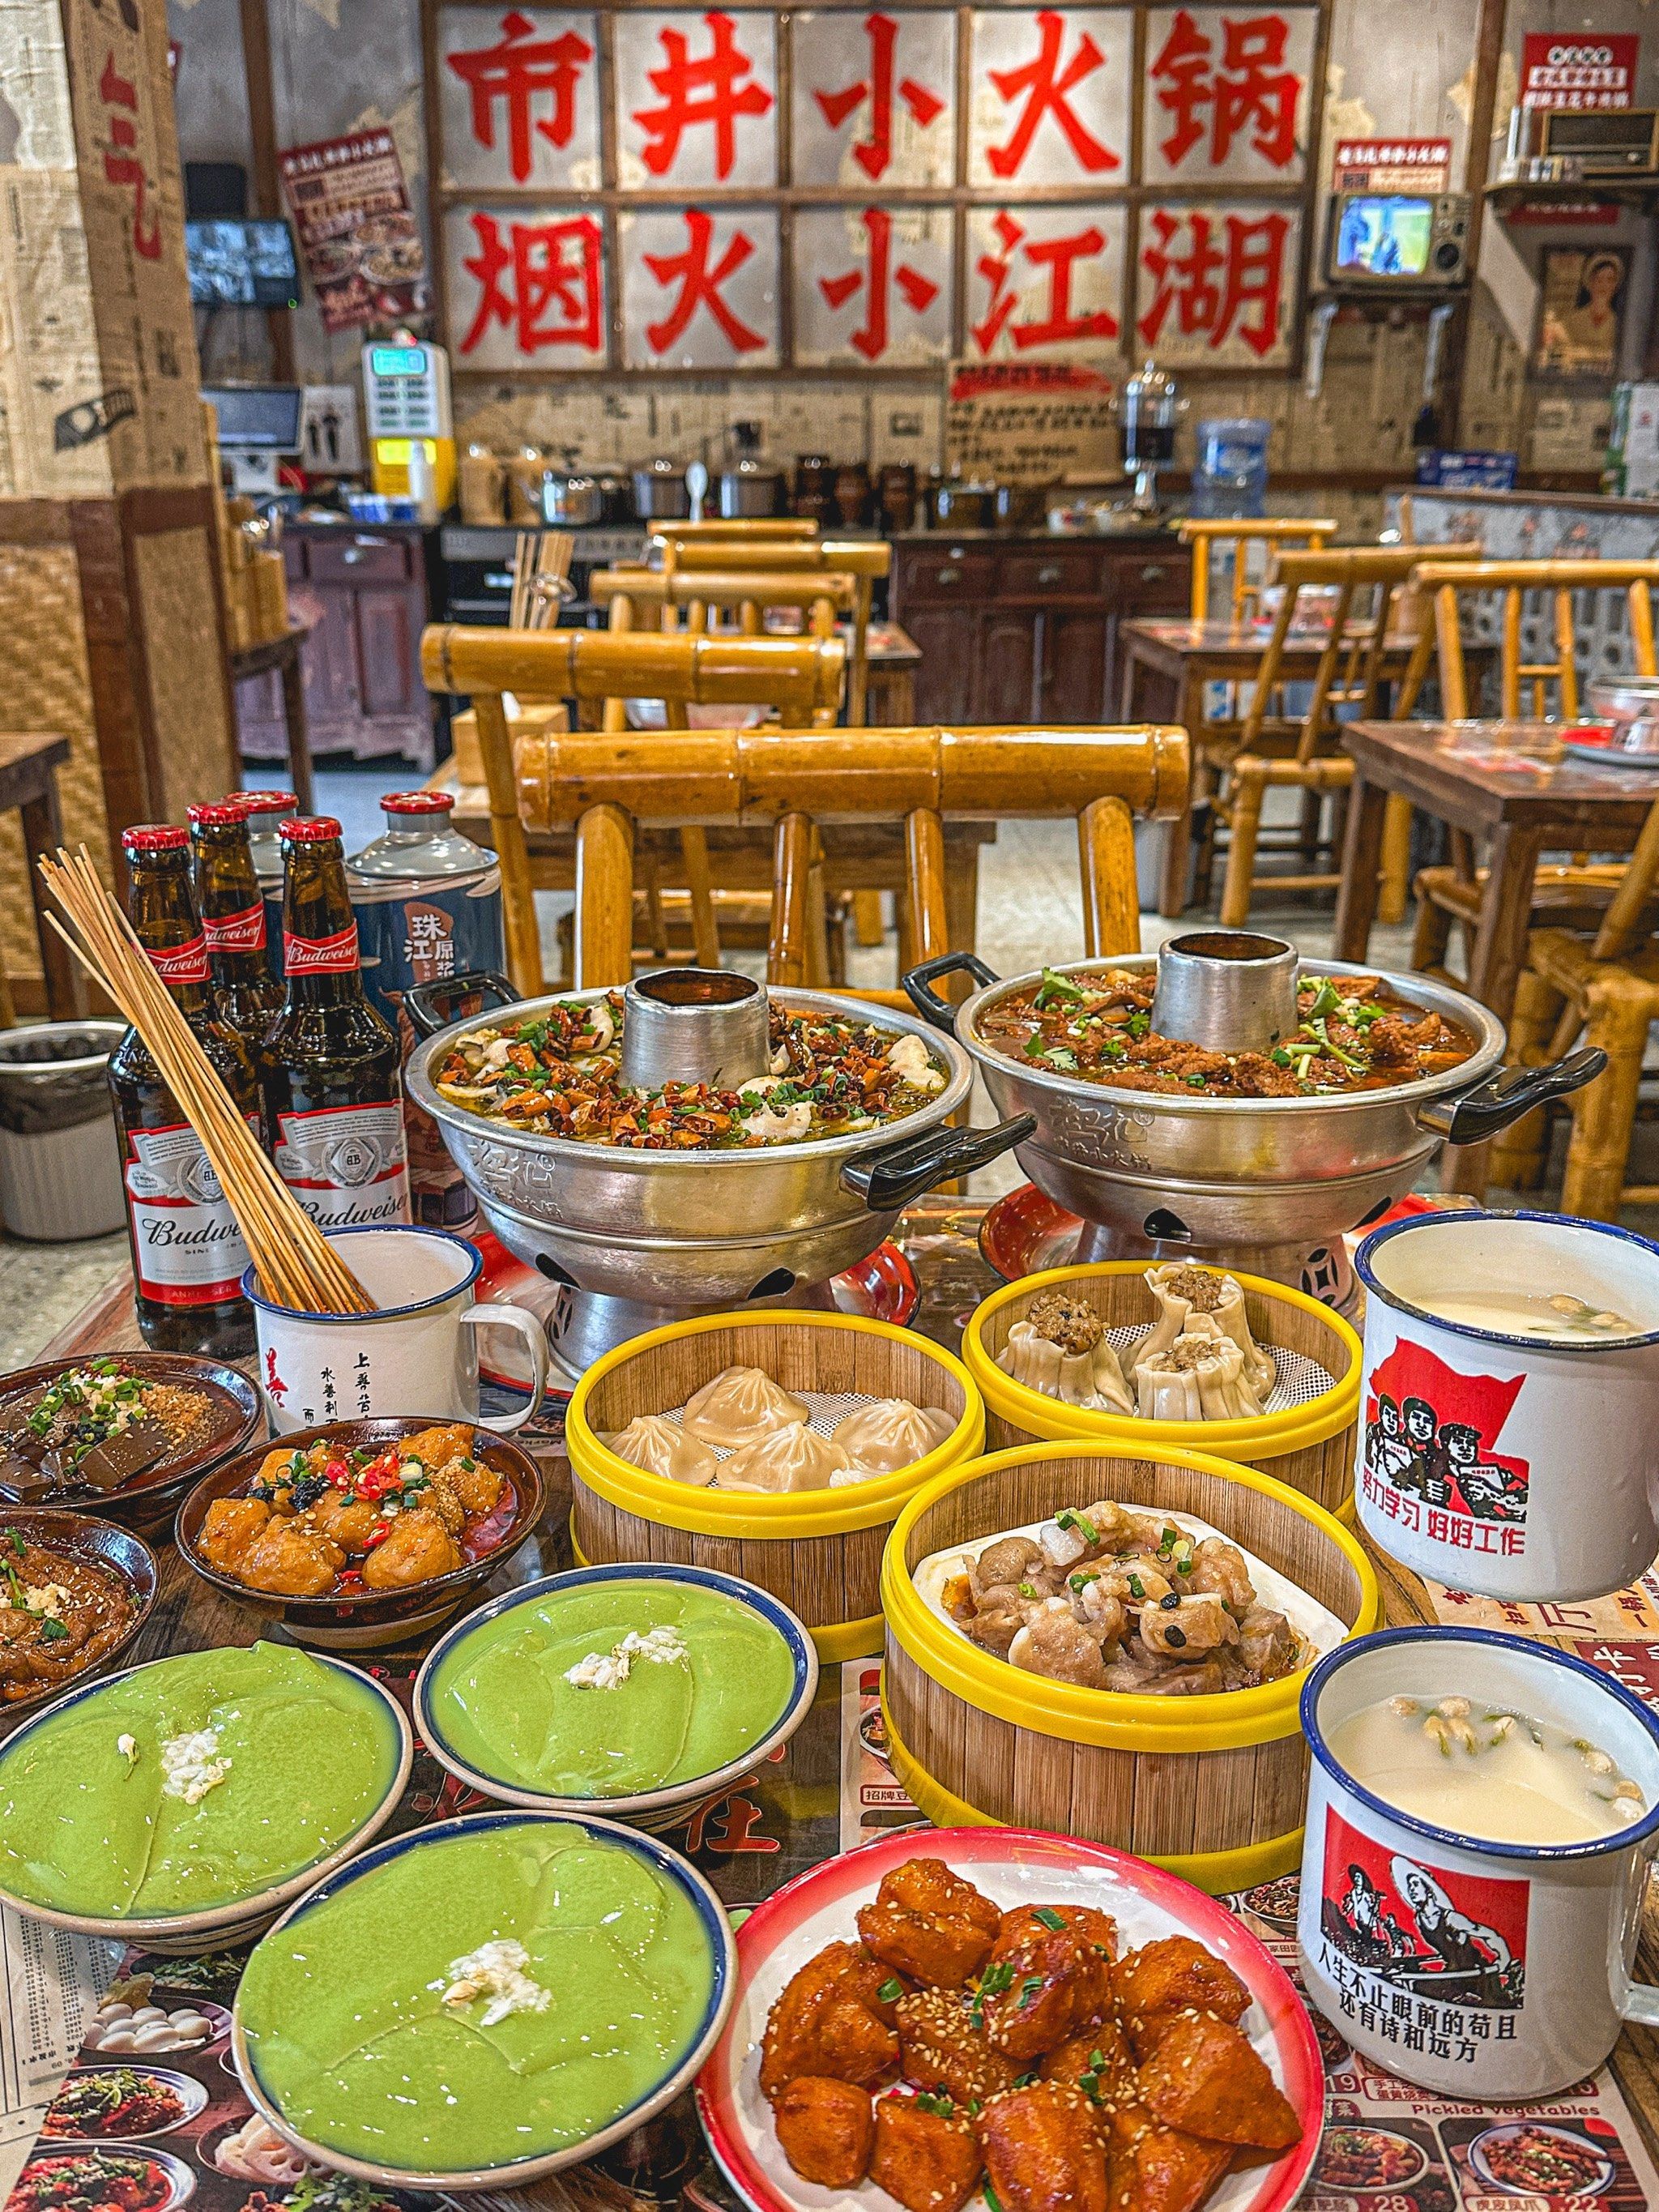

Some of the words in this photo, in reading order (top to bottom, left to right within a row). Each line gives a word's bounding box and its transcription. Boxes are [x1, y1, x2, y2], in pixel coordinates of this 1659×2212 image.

[447, 9, 1301, 183] 市井小火锅
[459, 206, 1290, 361] 烟火小江湖
[143, 1218, 243, 1246] Budwe
[354, 1352, 371, 1418] 上善若
[1362, 1465, 1420, 1532] 努力学习
[1427, 1508, 1526, 1556] 好好工作
[866, 1790, 910, 1800] 招牌豆
[1319, 1942, 1517, 2039] 人生不止眼前的苟且
[1339, 1986, 1478, 2063] 还有诗和远方
[1325, 2074, 1355, 2092] 19
[1412, 2104, 1484, 2115] Pickled
[1375, 2195, 1410, 2212] 28
[1564, 2195, 1599, 2212] 22
